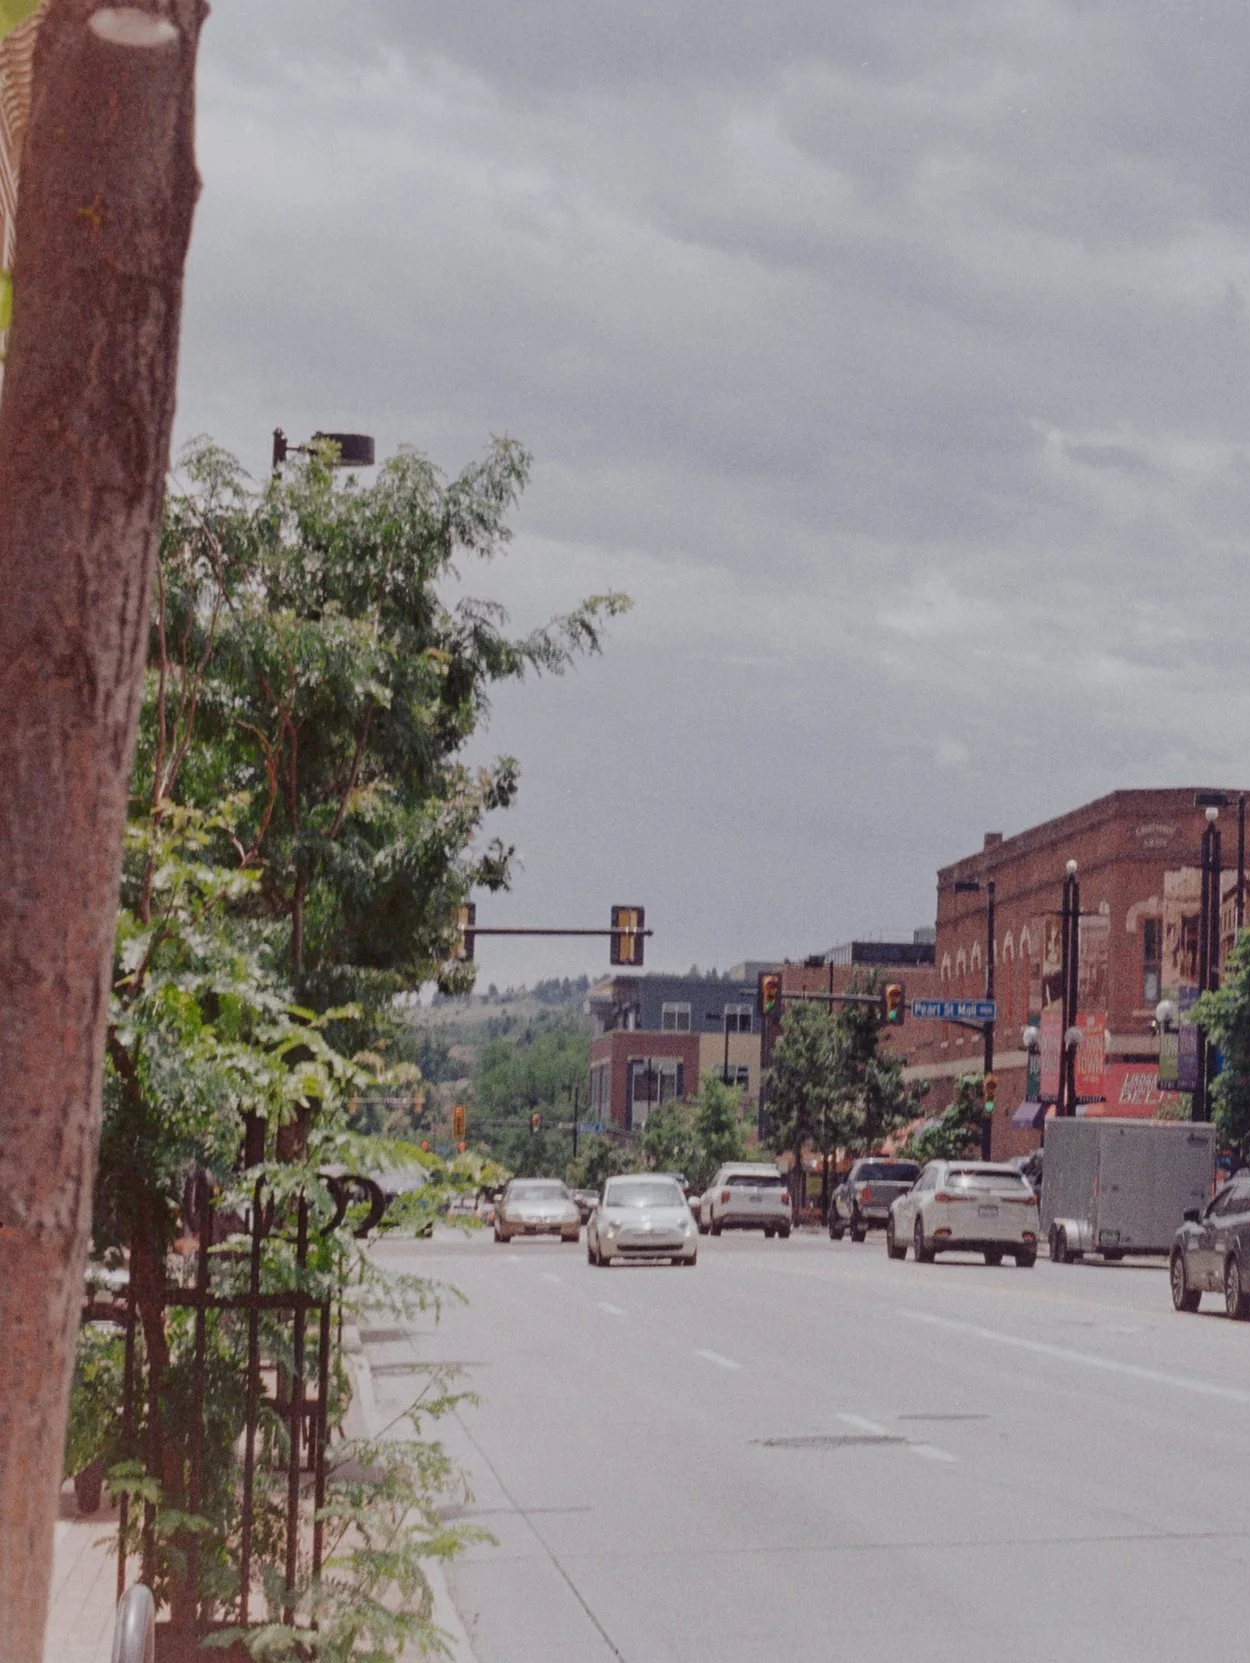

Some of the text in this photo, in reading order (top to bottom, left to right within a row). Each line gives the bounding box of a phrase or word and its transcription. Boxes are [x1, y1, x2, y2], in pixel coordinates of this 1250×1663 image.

[914, 1001, 940, 1016] Pearl
[958, 1001, 977, 1017] Mall
[1119, 1089, 1164, 1105] DELI
